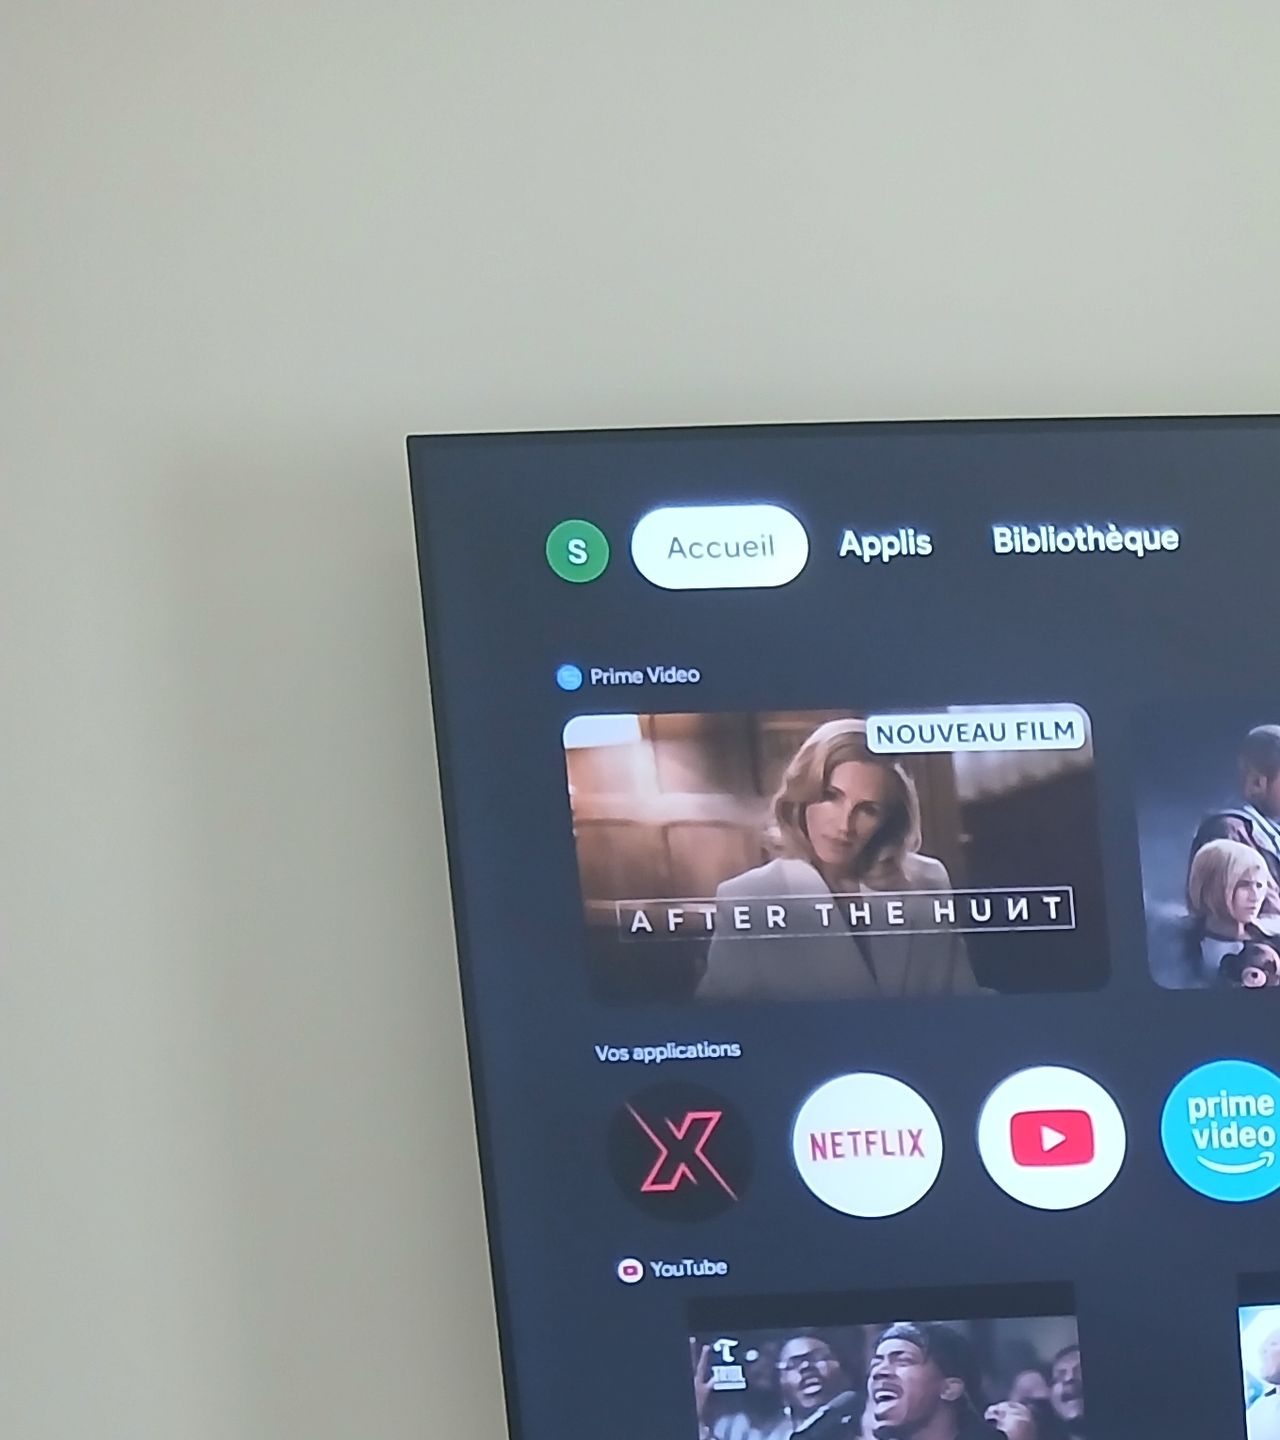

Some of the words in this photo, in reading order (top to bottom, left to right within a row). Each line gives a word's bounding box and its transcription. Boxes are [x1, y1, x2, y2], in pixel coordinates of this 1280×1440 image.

[667, 535, 775, 561] Accueil
[840, 529, 933, 562] Applis
[993, 525, 1180, 558] Bibliothèque
[590, 667, 644, 685] Prime
[646, 665, 701, 683] Video
[876, 721, 1007, 746] NOUVEAU
[1016, 719, 1076, 742] FILM
[630, 904, 787, 934] AFTER
[815, 900, 905, 928] THE
[595, 1044, 630, 1063] Vos
[632, 1041, 742, 1064] applications
[1187, 1090, 1275, 1124] prime
[810, 1128, 926, 1161] NETFLIX
[1192, 1121, 1276, 1150] video
[650, 1258, 728, 1278] YouTube
